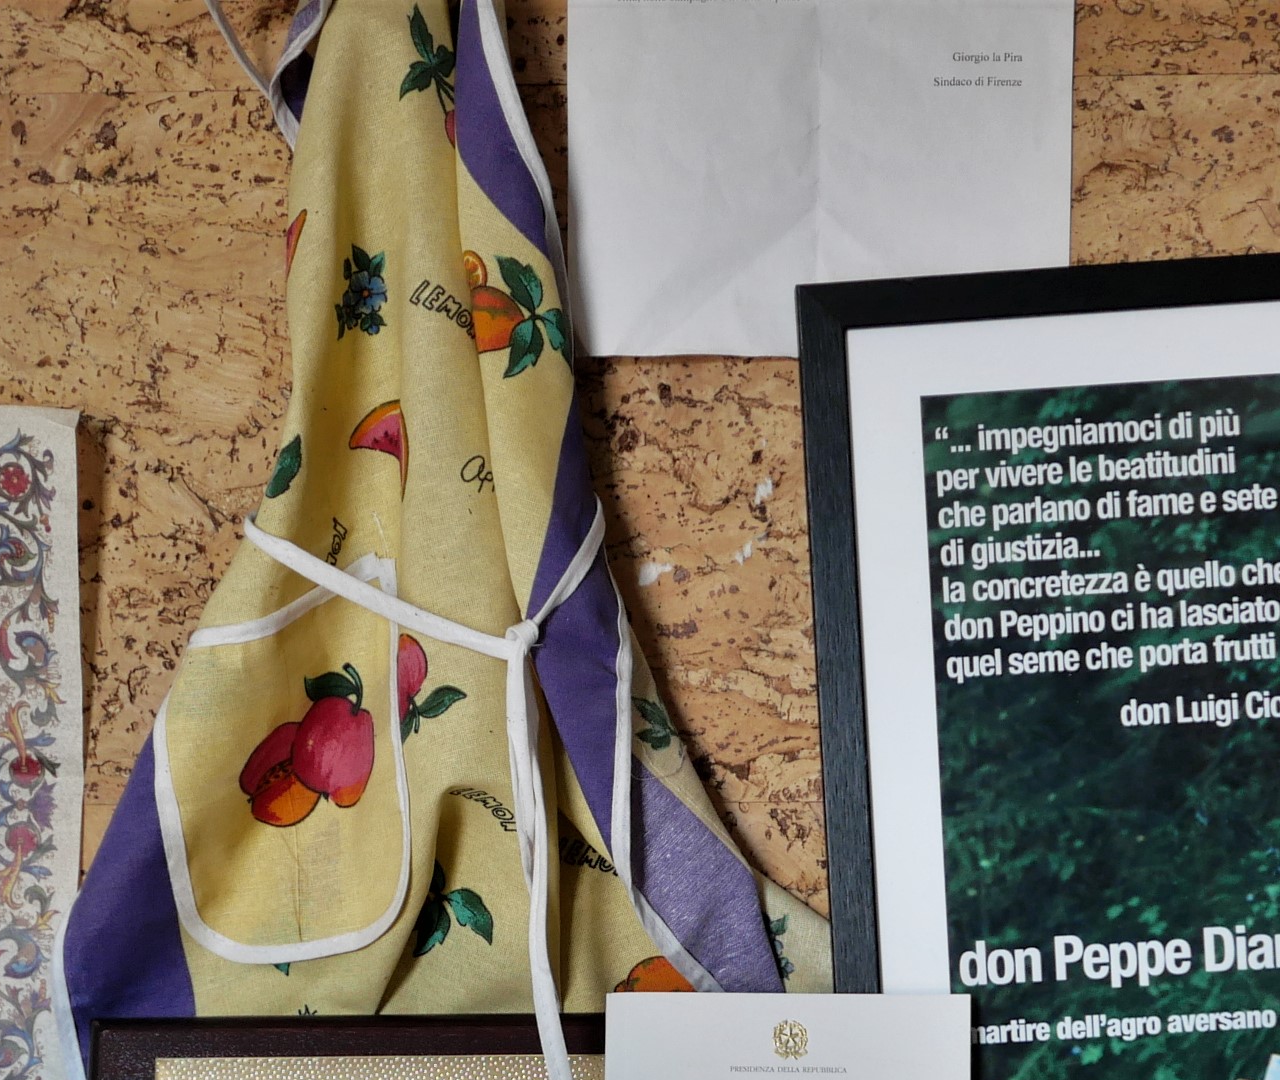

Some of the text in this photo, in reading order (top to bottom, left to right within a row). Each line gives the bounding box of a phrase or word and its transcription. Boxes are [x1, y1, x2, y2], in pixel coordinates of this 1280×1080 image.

[952, 51, 1022, 64] Giorgio la Pira
[933, 76, 1022, 87] Sindaco di Firenze
[978, 412, 1162, 454] impegniamoci
[1169, 411, 1193, 439] di
[1200, 407, 1240, 443] più
[936, 446, 1235, 496] per vivere le beatitudini
[938, 483, 1277, 529] che parlano di fame e sete
[940, 531, 1100, 570] di giustizia...
[942, 576, 965, 603] la
[972, 568, 1128, 602] concretezza
[1135, 564, 1151, 591] è
[1157, 560, 1235, 596] quello
[944, 613, 993, 641] don
[1000, 607, 1105, 645] Peppino
[1111, 603, 1133, 631] ci
[1140, 600, 1174, 629] ha
[946, 649, 1002, 683] quel
[1008, 649, 1080, 674] seme
[1086, 641, 1133, 669] che
[1139, 637, 1208, 671] porta
[1213, 631, 1276, 663] frutti
[1120, 697, 1170, 727] don
[1176, 692, 1239, 726] Luigi
[959, 940, 1042, 987] don
[1053, 934, 1192, 988] Peppe
[1167, 1008, 1277, 1033] aversano
